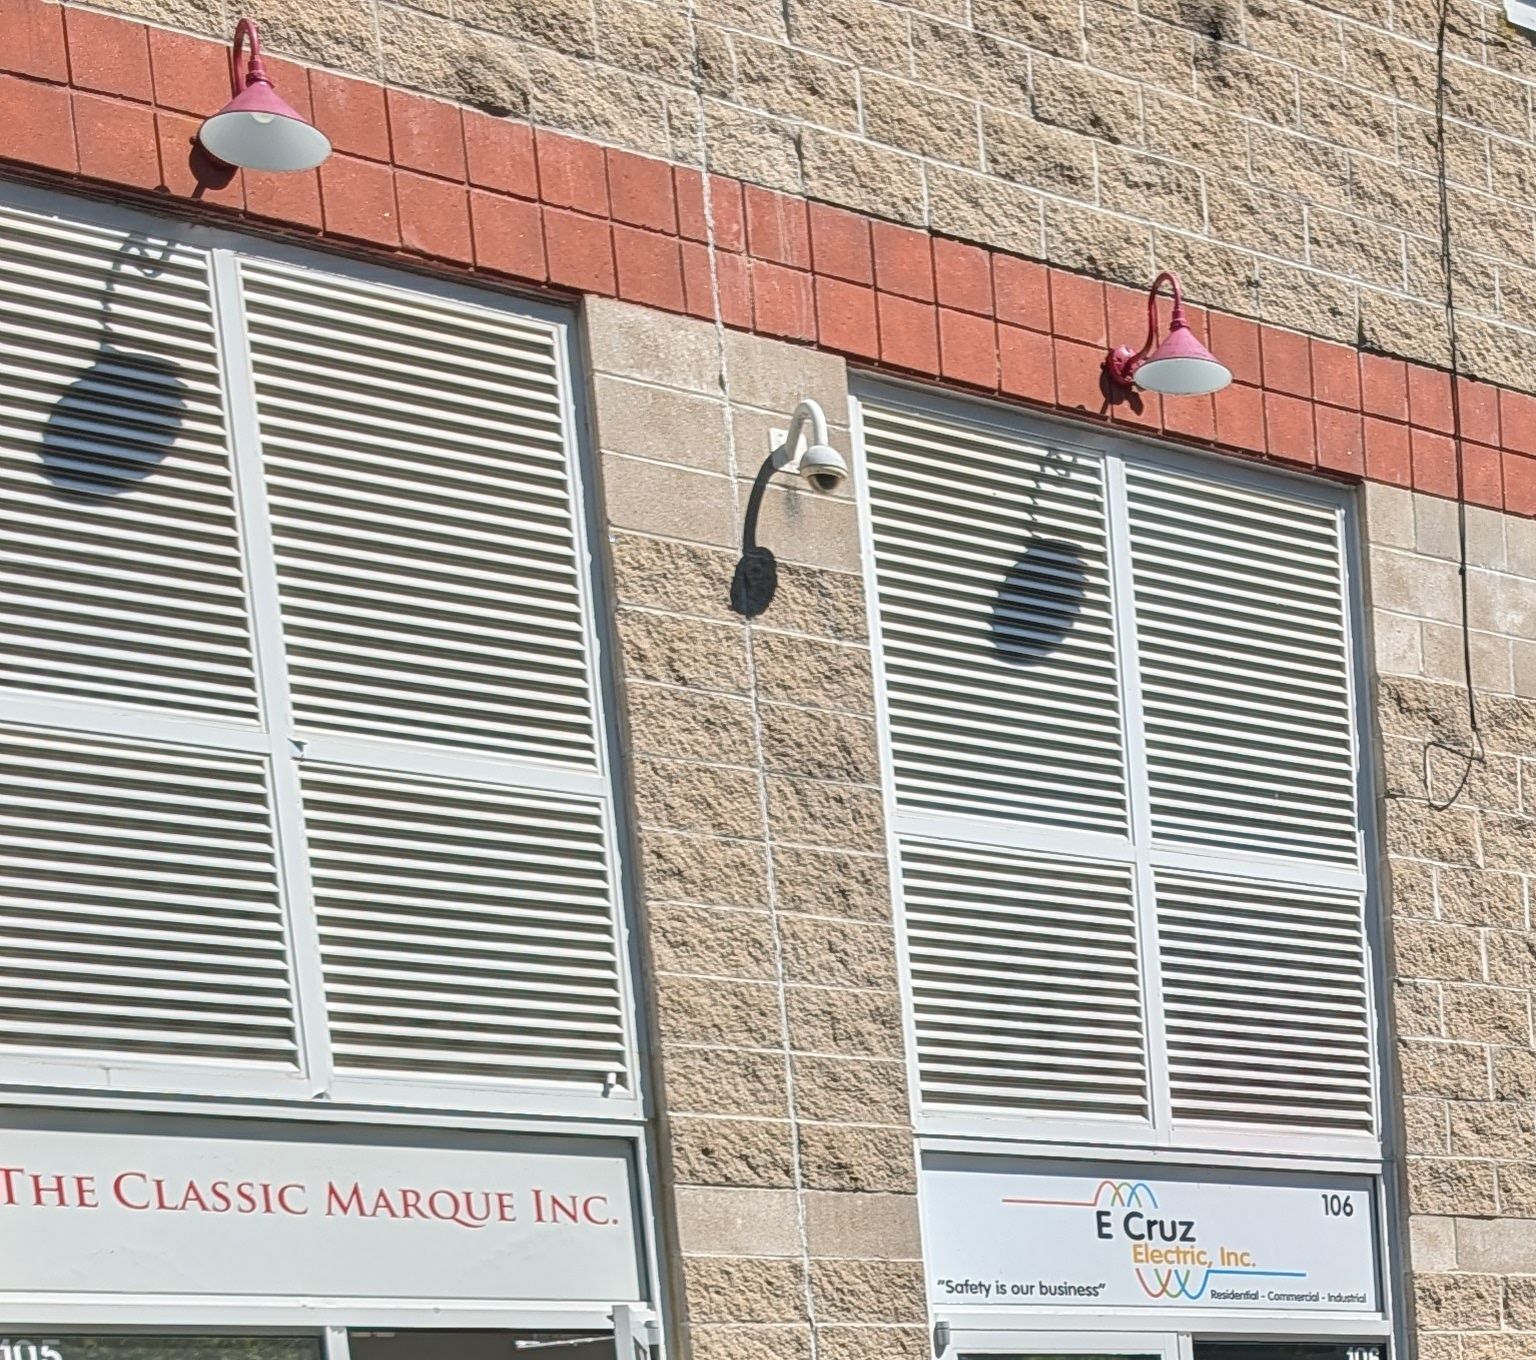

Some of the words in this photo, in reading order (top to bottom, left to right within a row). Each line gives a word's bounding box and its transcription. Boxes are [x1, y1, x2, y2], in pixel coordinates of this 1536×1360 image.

[0, 1166, 99, 1210] THE
[112, 1171, 309, 1216] CLASSIC
[324, 1181, 517, 1229] MARQUE
[532, 1188, 620, 1226] INC.
[1322, 1193, 1354, 1218] 106
[1096, 1209, 1113, 1240] E
[1123, 1212, 1196, 1243] Cruz
[1132, 1244, 1214, 1269] Electric,
[1220, 1246, 1257, 1268] Inc.
[995, 1282, 1007, 1295] is
[1011, 1285, 1036, 1296] our
[1210, 1289, 1259, 1301] Residential
[1267, 1291, 1320, 1303] Commercial
[1328, 1293, 1367, 1304] Industrial
